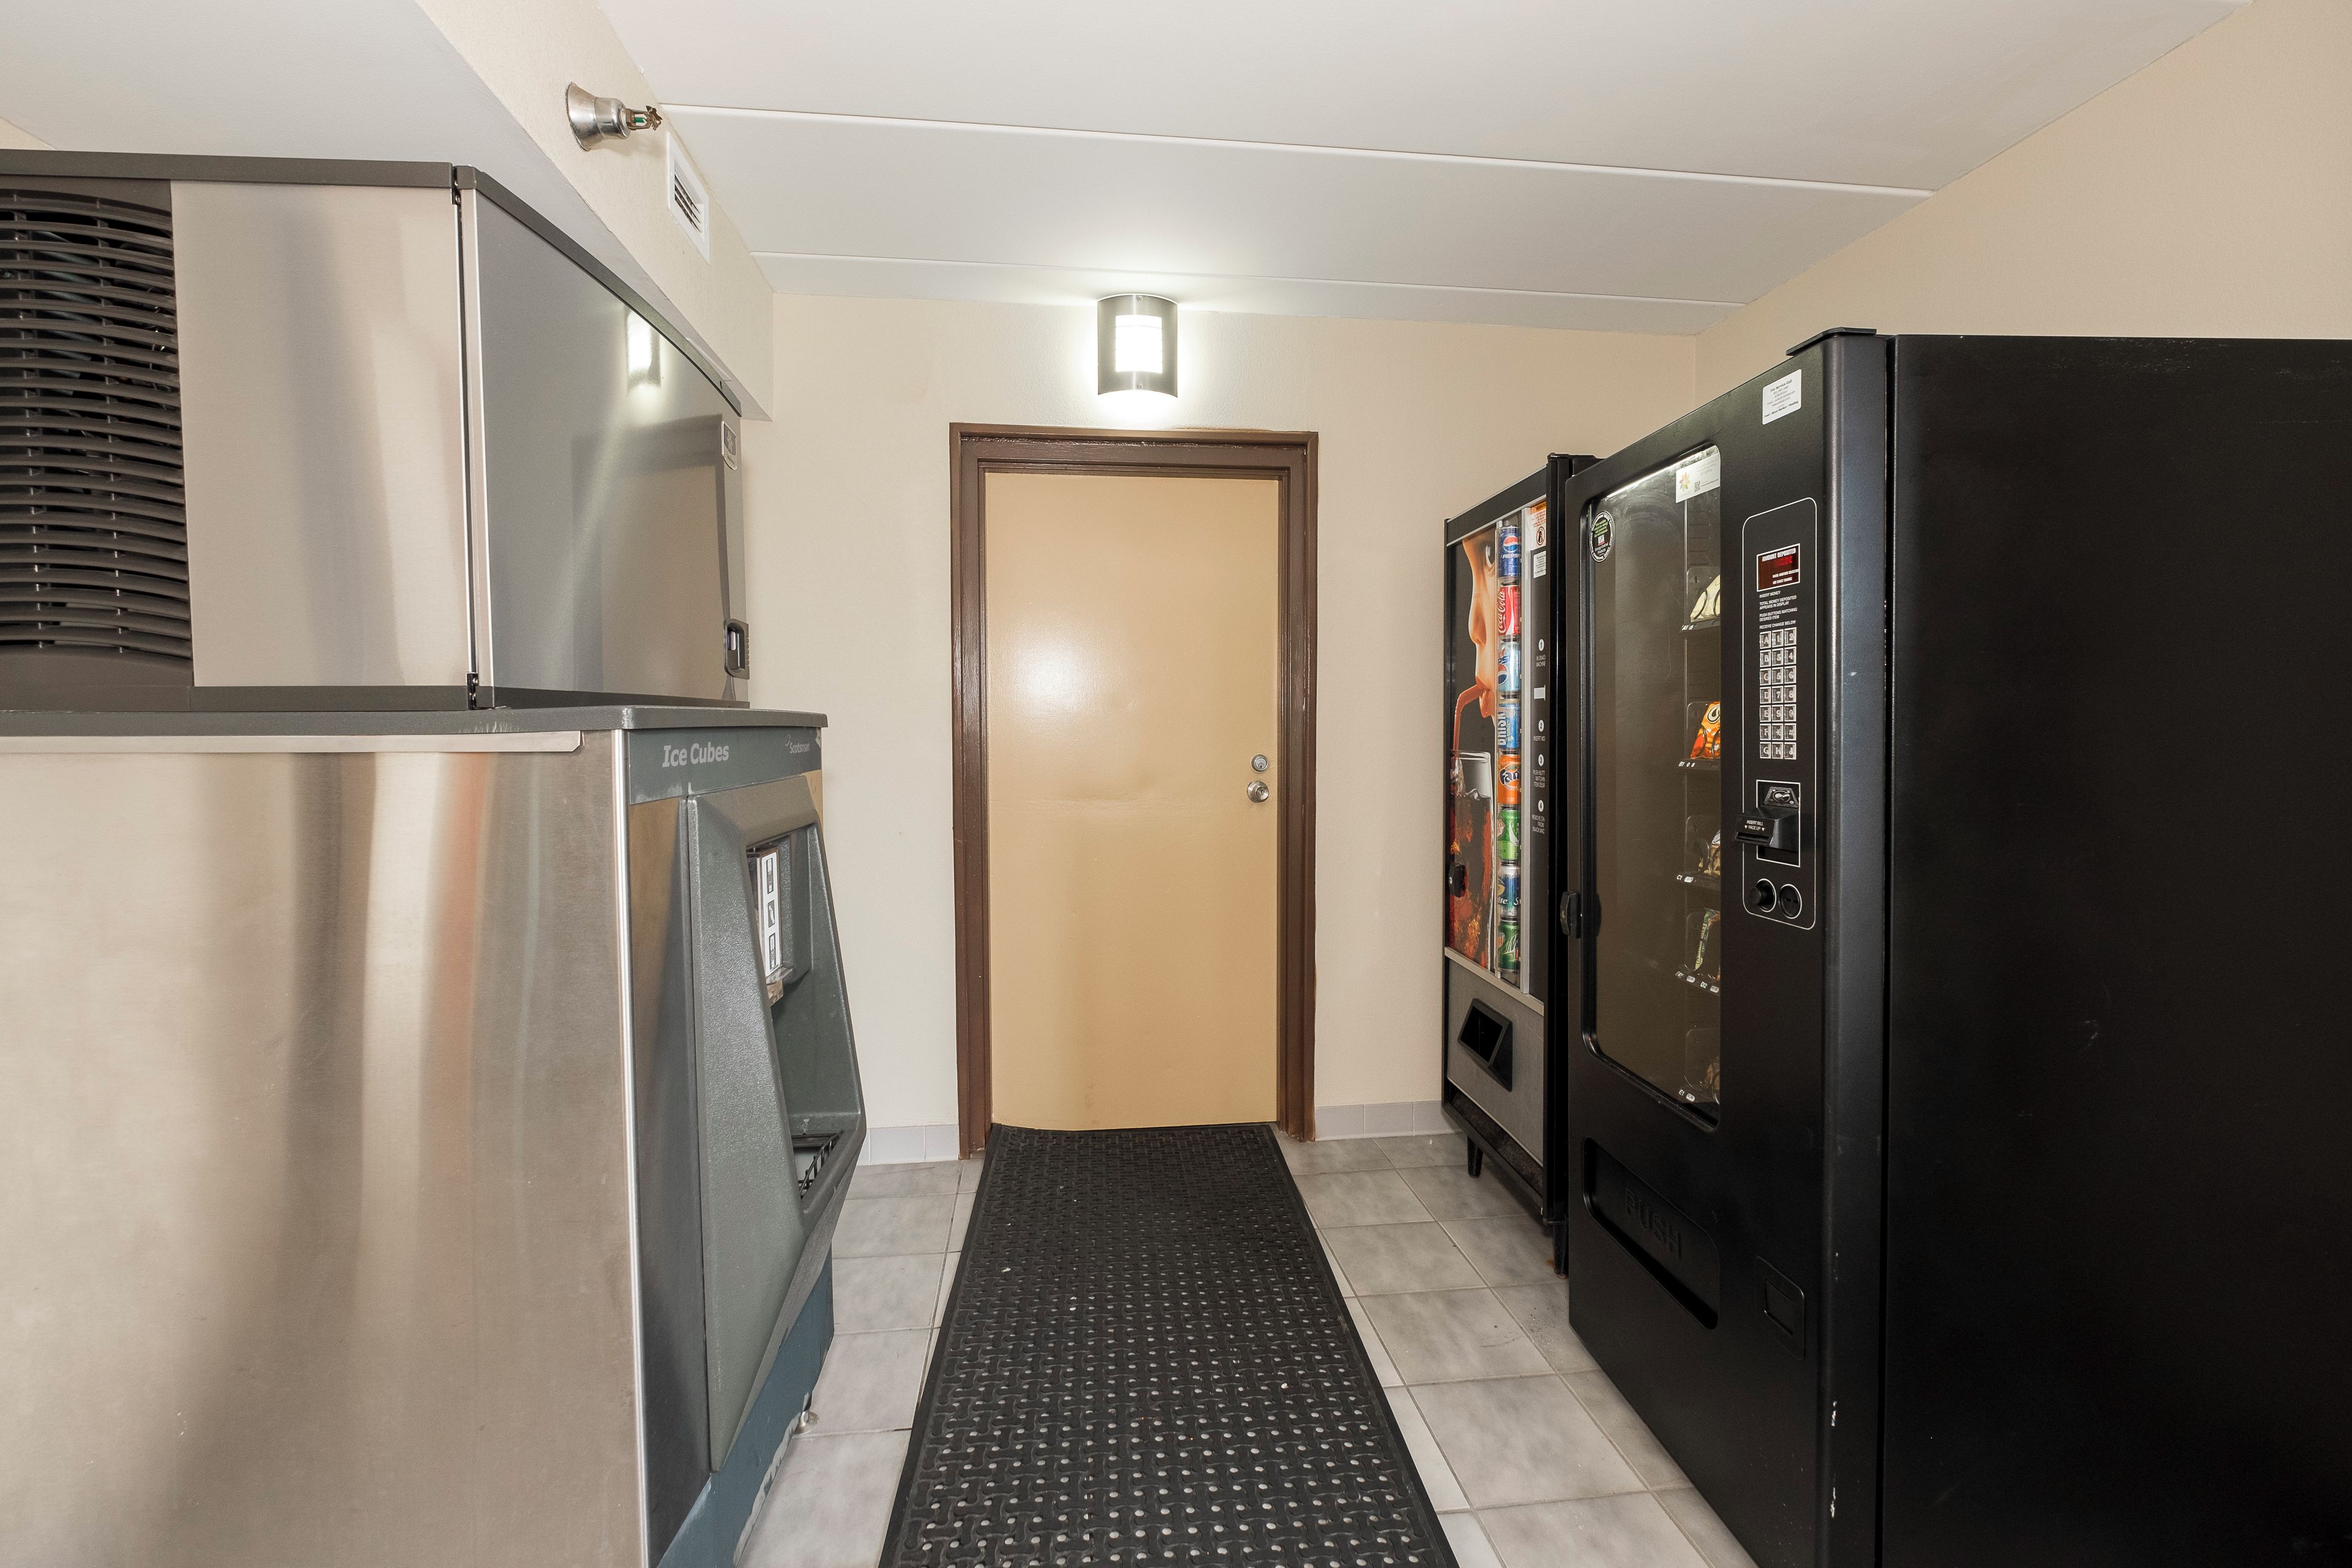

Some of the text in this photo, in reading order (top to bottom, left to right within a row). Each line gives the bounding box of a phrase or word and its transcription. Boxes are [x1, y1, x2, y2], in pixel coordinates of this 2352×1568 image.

[662, 741, 729, 768] Ice Cubes
[789, 742, 810, 754] Scotsman
[1500, 769, 1519, 785] Fan
[1625, 1188, 1681, 1260] PUSH
